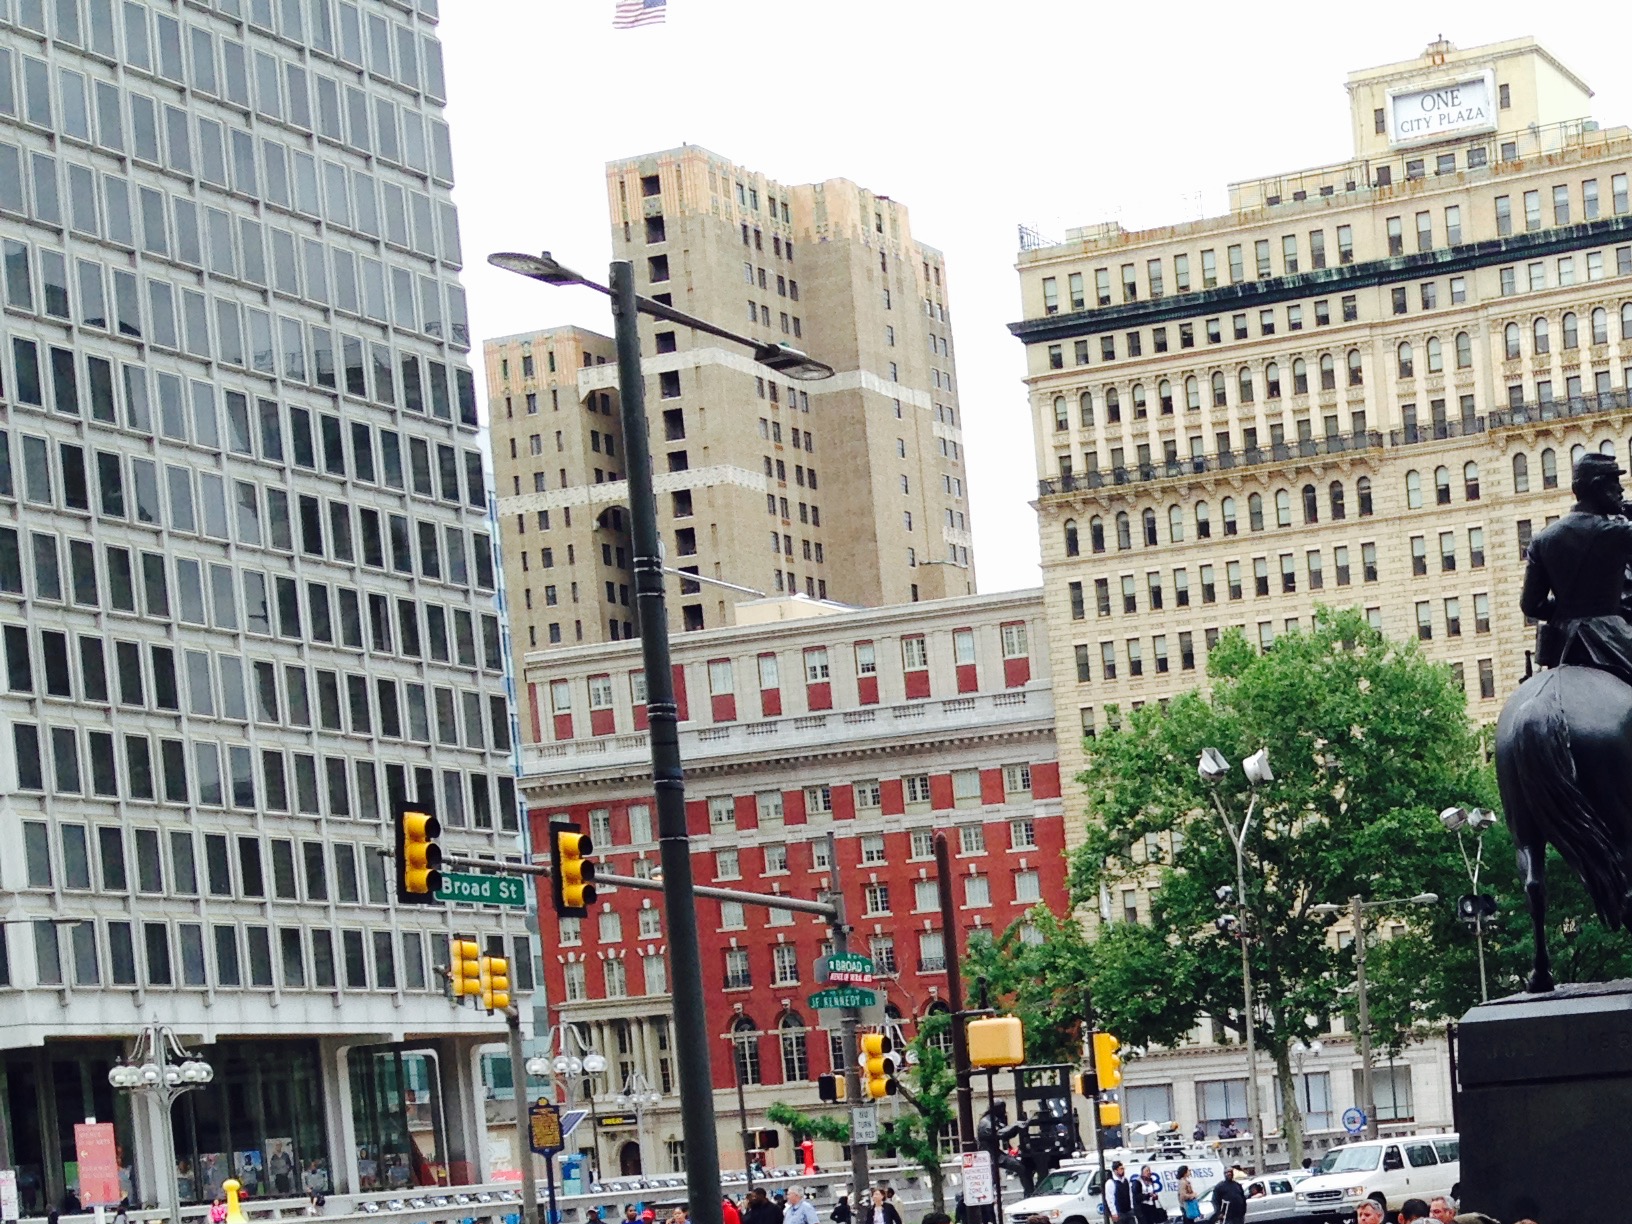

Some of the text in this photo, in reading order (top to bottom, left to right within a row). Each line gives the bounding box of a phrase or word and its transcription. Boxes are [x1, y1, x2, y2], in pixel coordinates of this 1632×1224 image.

[1421, 88, 1462, 112] ONE
[1400, 106, 1485, 133] CITY PLAZA
[441, 876, 517, 899] Broad St
[836, 960, 862, 972] BROAD
[823, 996, 860, 1008] KENNEDY
